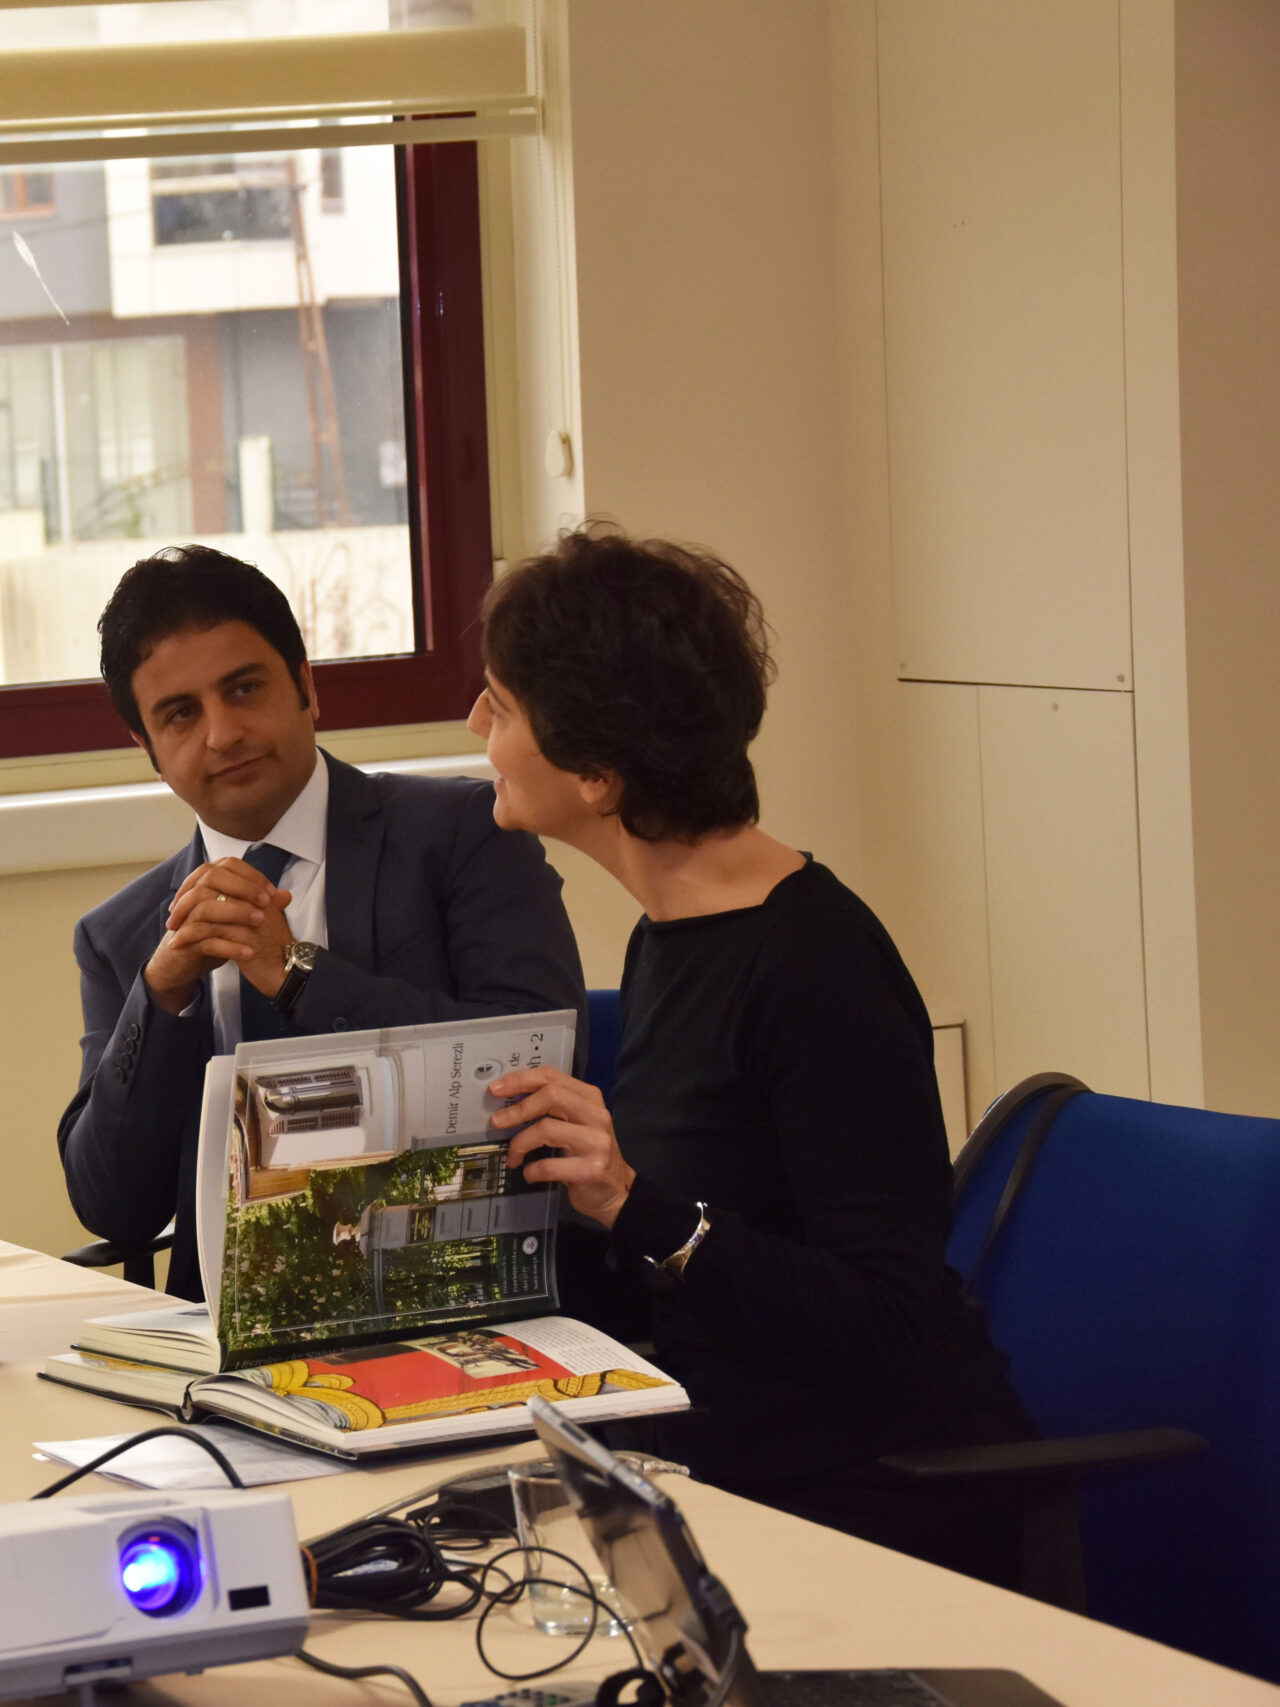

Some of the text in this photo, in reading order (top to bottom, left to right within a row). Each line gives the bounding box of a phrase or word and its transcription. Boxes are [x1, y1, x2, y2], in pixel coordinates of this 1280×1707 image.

[508, 1051, 521, 1067] de
[445, 1042, 464, 1135] Demir Alp Serezli
